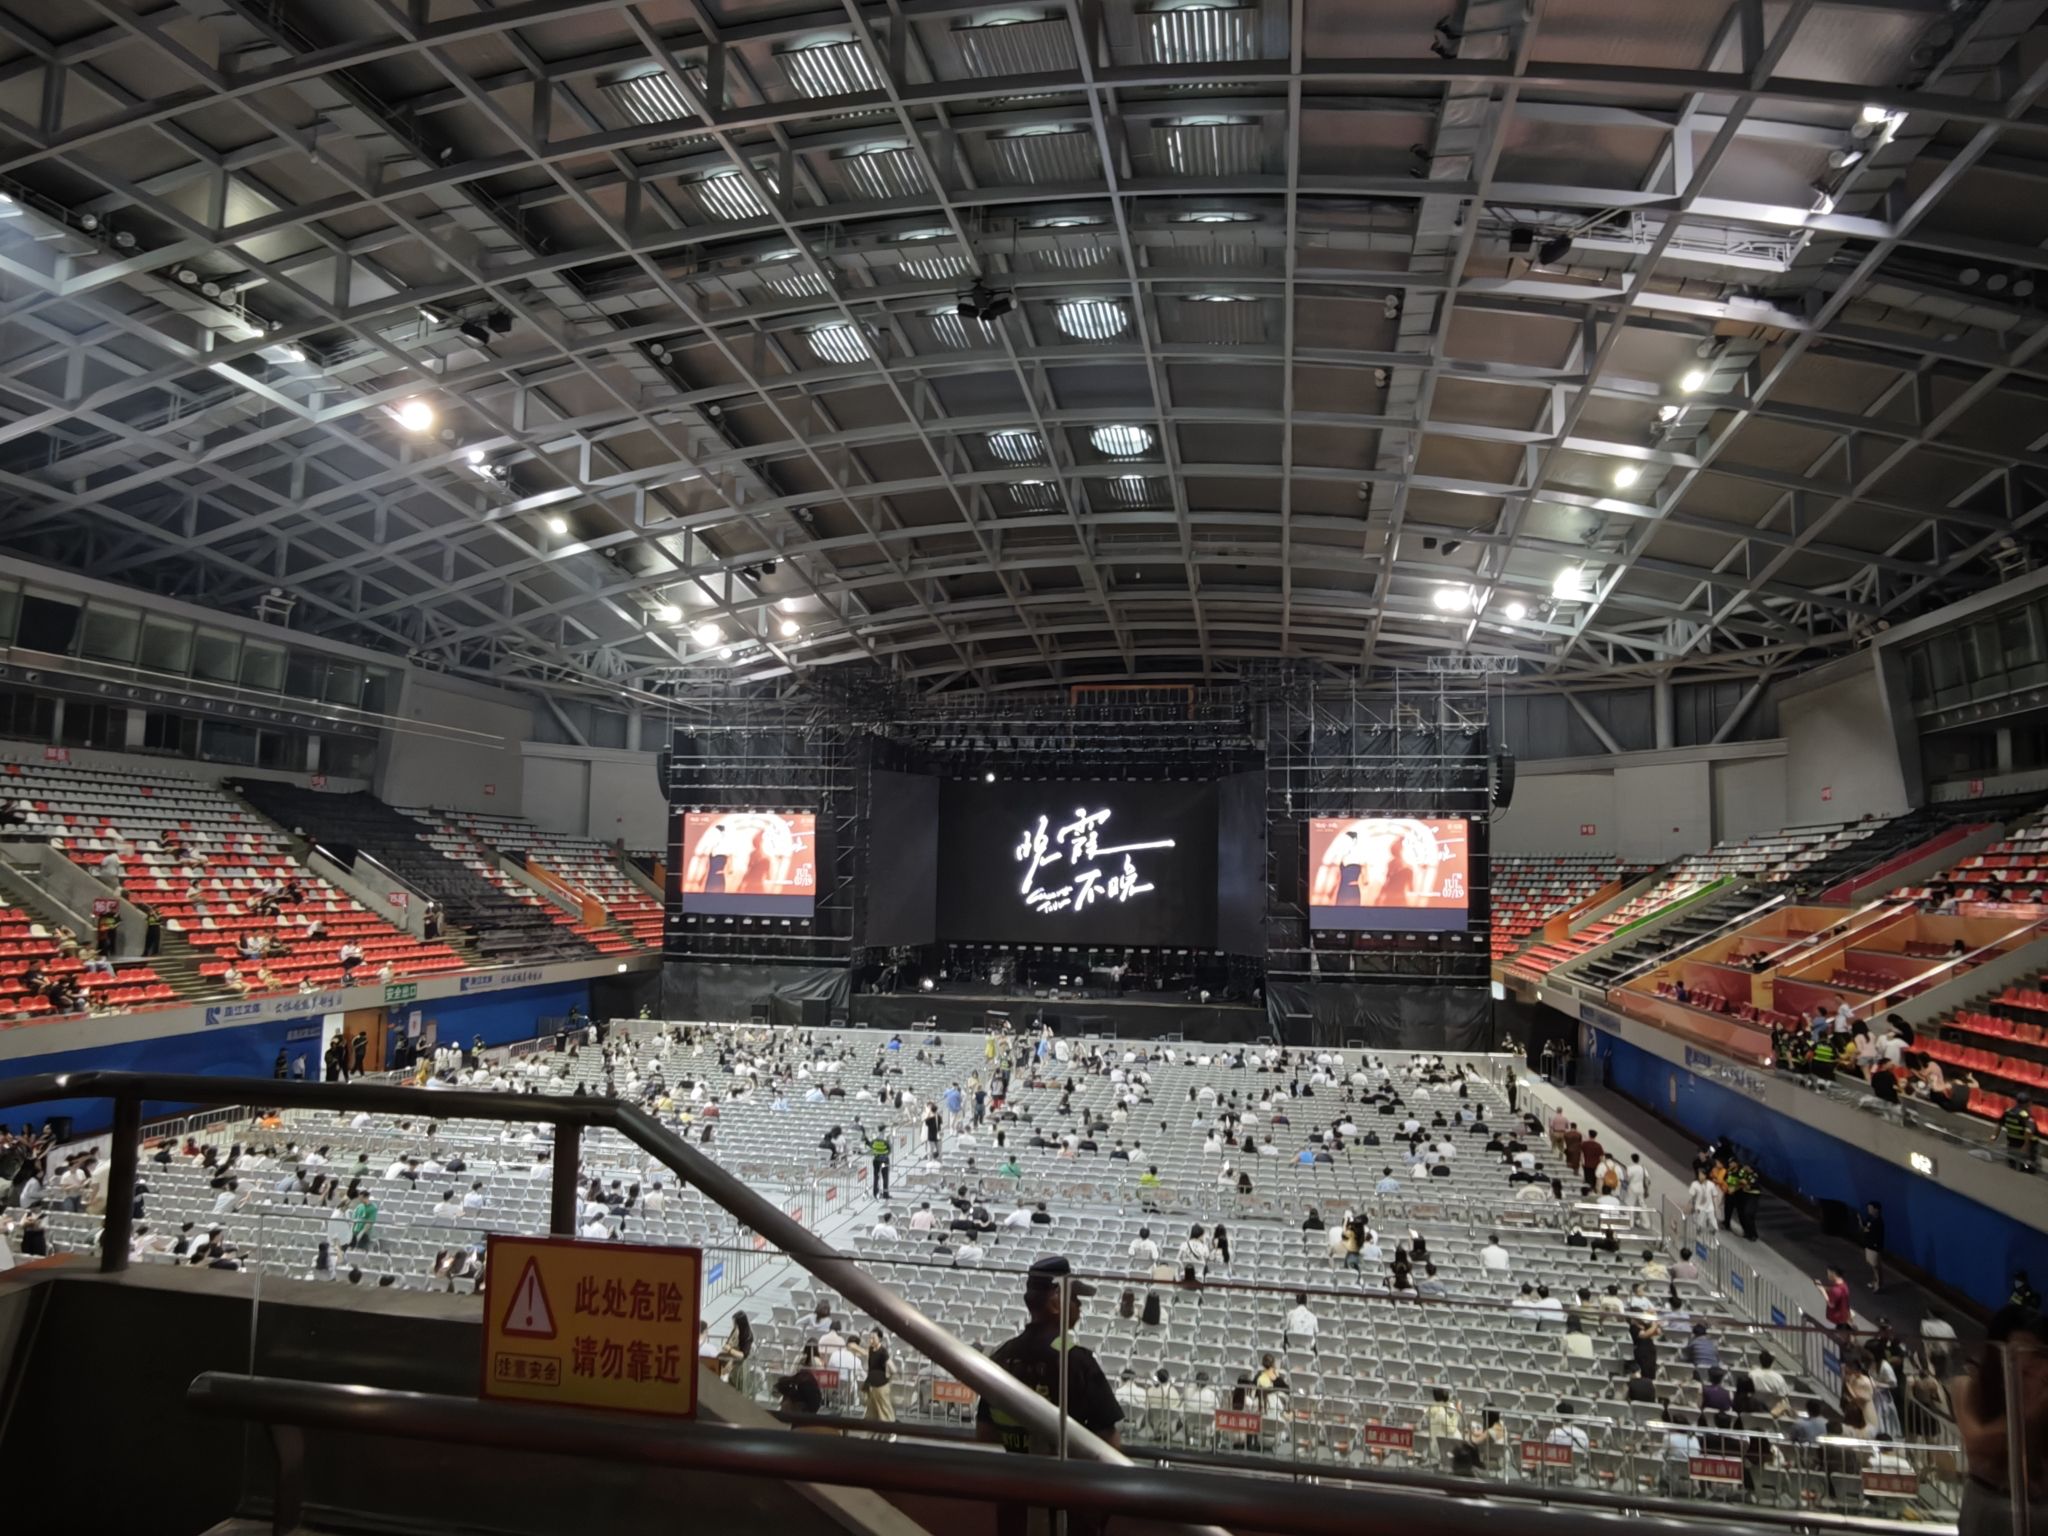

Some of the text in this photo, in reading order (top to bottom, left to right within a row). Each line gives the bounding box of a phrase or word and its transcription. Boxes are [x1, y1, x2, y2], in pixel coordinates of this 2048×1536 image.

[386, 985, 417, 1000] 安全出口
[575, 1275, 683, 1322] 此处危险
[498, 1358, 558, 1381] 注意安全
[572, 1336, 680, 1384] 请勿靠近
